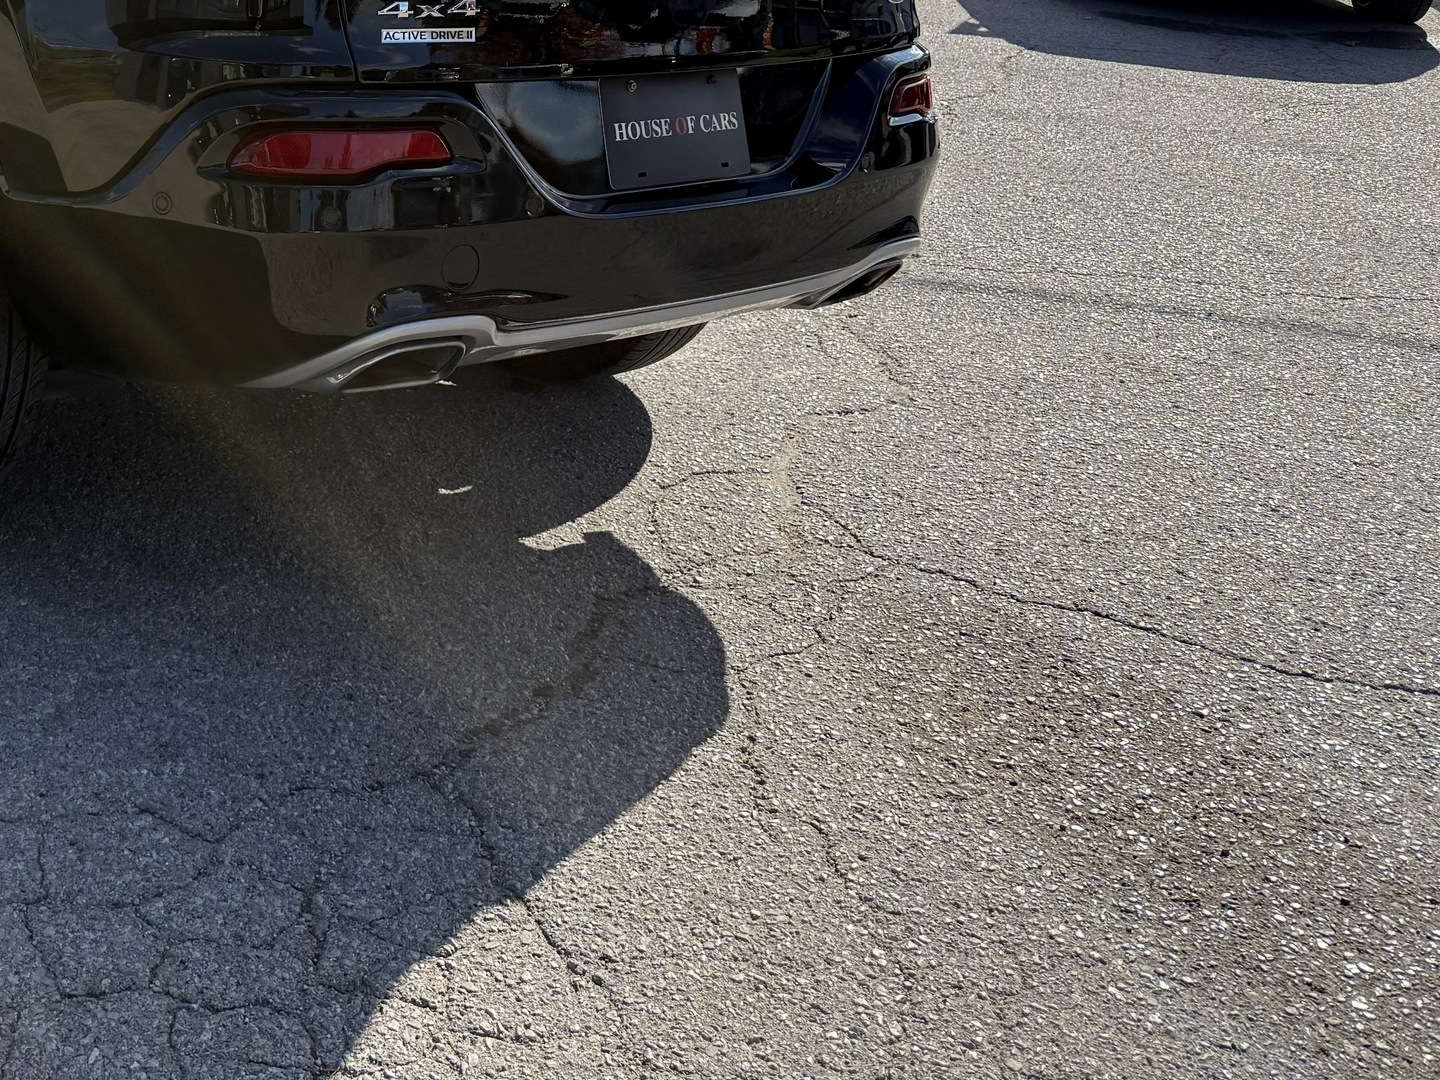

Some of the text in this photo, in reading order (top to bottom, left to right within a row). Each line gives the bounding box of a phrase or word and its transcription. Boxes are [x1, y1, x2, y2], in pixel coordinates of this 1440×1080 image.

[378, 0, 480, 18] 4x4
[384, 30, 427, 41] ACTIVE
[431, 30, 464, 40] DRIVE
[614, 111, 738, 141] HOUSE OF CARS
